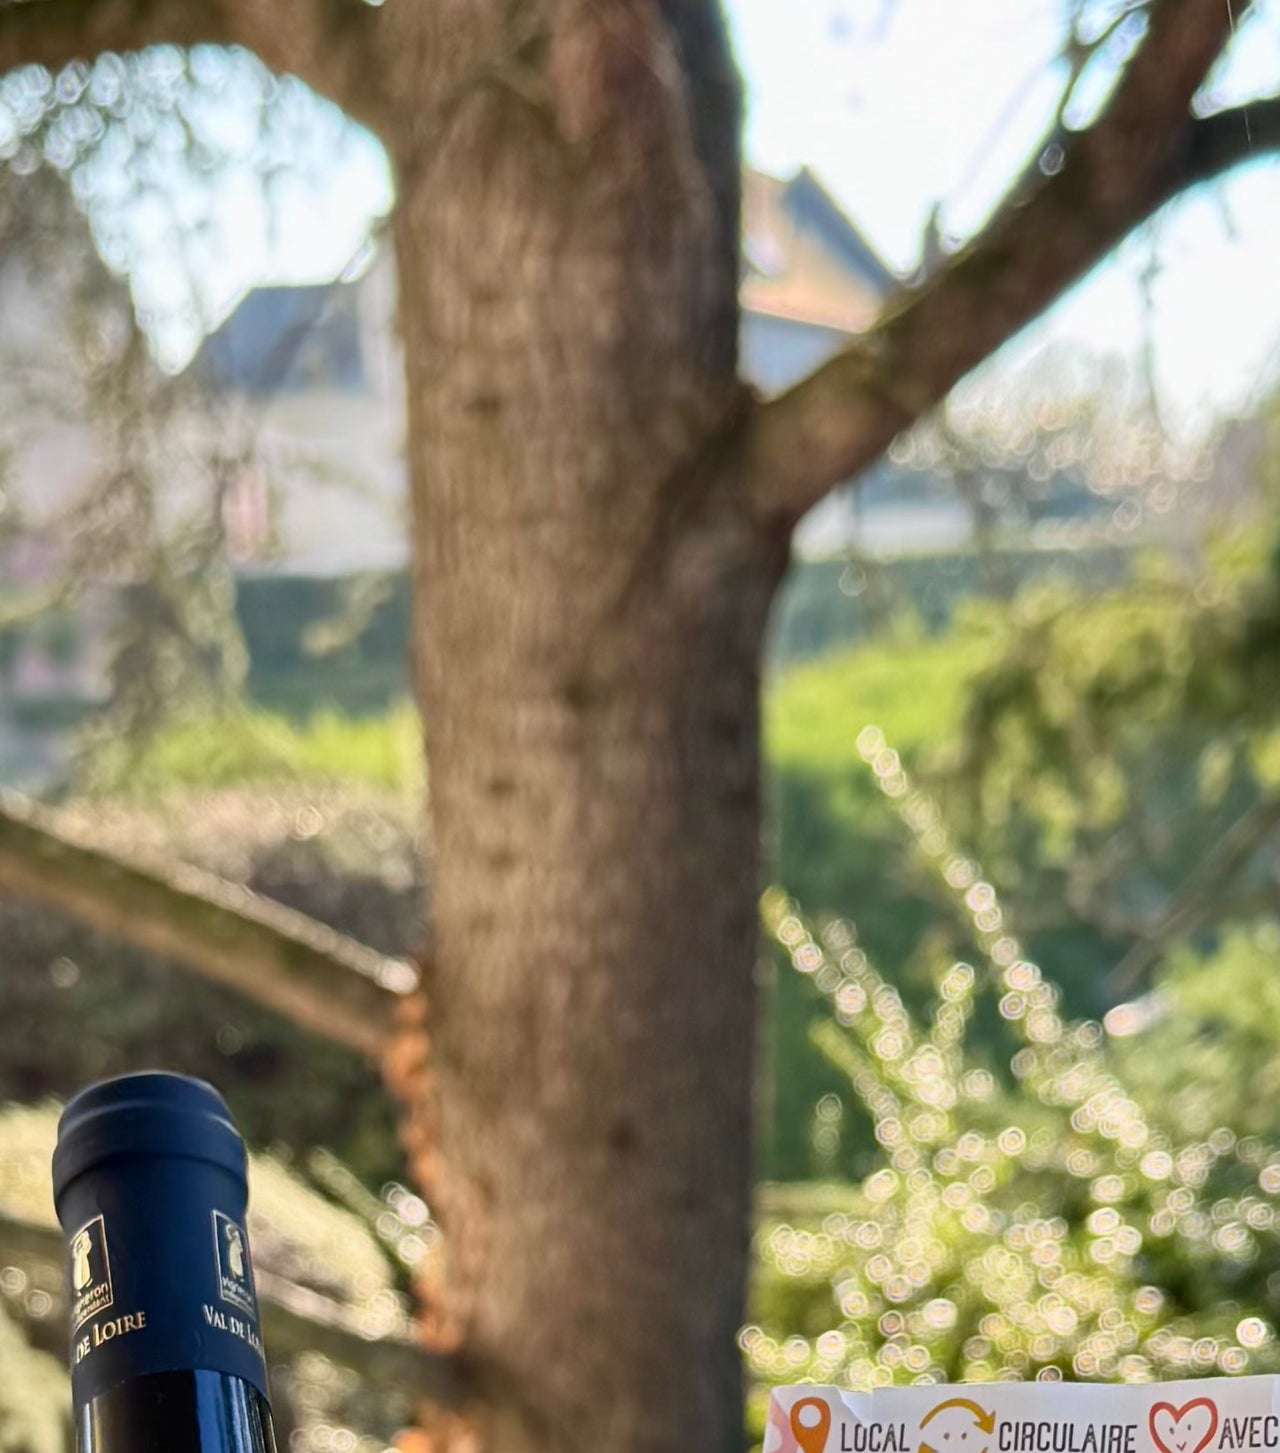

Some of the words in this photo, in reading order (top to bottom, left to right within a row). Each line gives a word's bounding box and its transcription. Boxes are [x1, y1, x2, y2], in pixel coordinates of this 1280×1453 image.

[841, 1422, 910, 1453] LOCAL
[998, 1422, 1138, 1453] CIRCULAIRE
[1218, 1419, 1279, 1449] AVEC
